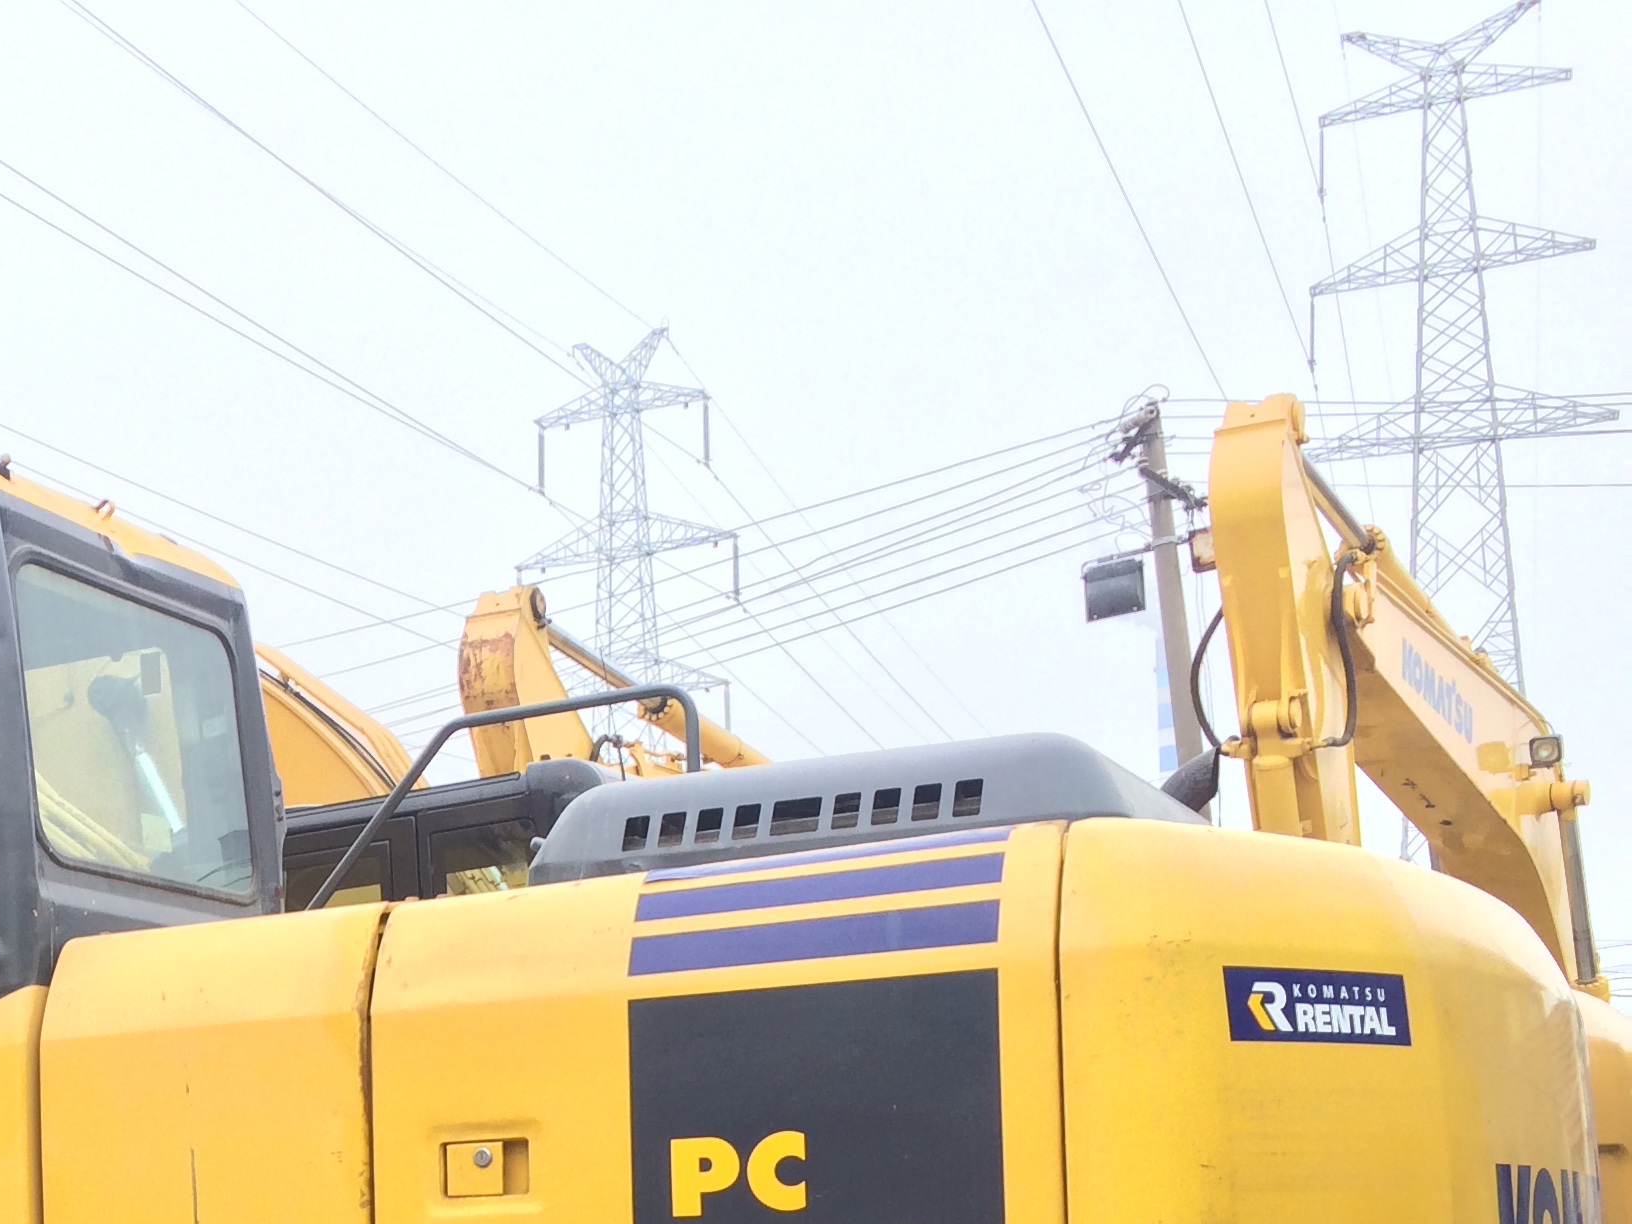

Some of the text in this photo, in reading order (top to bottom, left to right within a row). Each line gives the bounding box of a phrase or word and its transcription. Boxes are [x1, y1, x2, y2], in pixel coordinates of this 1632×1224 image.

[1401, 636, 1473, 744] KOMATSU
[1291, 983, 1387, 1002] KOMATSU
[1294, 1002, 1397, 1037] RENTAL
[670, 1130, 807, 1218] PC
